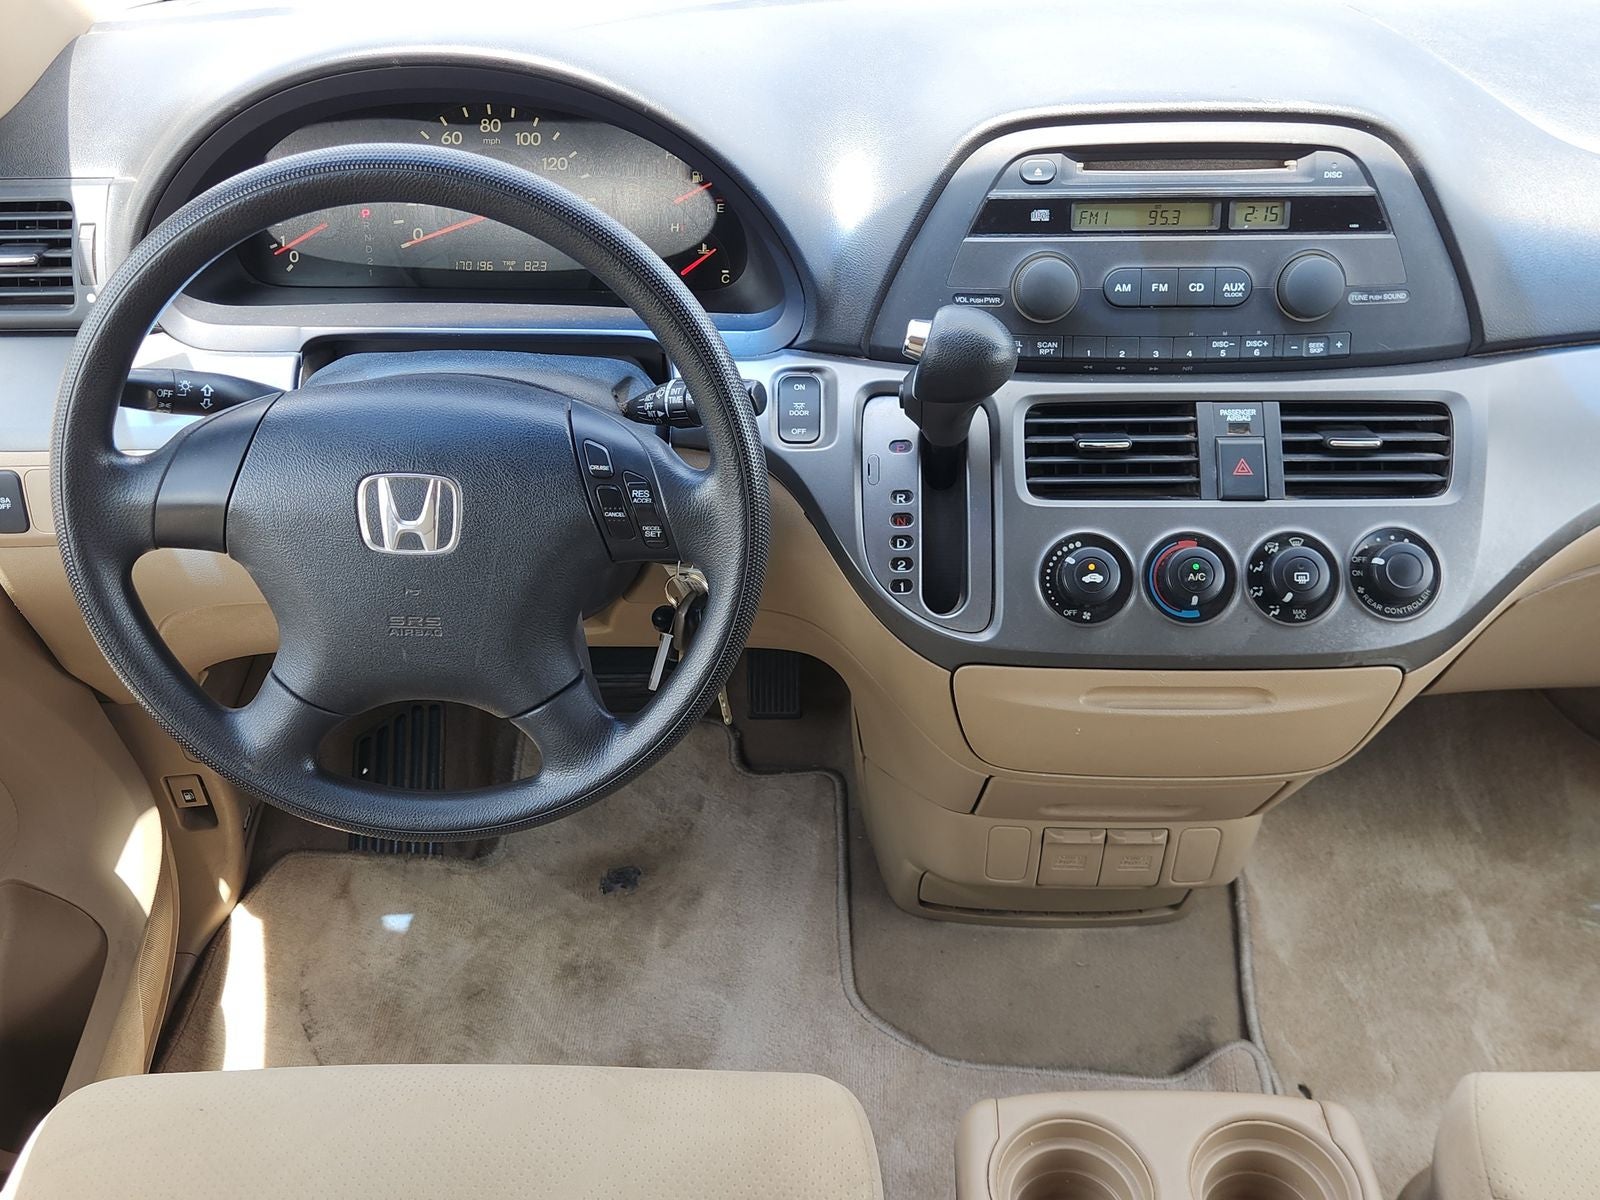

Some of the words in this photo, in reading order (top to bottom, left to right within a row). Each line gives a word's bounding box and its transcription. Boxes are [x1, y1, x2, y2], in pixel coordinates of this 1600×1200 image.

[480, 119, 501, 133] 80
[441, 131, 462, 145] 60
[483, 138, 501, 146] mph
[515, 132, 541, 146] 100
[542, 157, 568, 171] 120
[1324, 171, 1343, 179] DISC
[716, 203, 725, 213] E
[361, 208, 371, 218] P
[1148, 209, 1181, 226] 95.3
[1244, 205, 1279, 222] 2:15
[671, 223, 680, 233] H
[412, 228, 424, 241] 0
[279, 235, 286, 247] 1
[289, 250, 300, 263] 0
[721, 273, 731, 284] C
[1114, 284, 1132, 293] AM
[1152, 284, 1169, 293] FM
[1188, 283, 1205, 292] CD
[1222, 283, 1246, 292] AUX
[1351, 294, 1369, 302] TUNE
[1382, 293, 1407, 301] SOUND
[1036, 341, 1058, 349] SCAN
[1039, 348, 1055, 356] RPT
[1119, 350, 1126, 358] 2
[1152, 350, 1159, 358] 3
[1186, 350, 1193, 358] 4
[670, 387, 682, 395] INT
[793, 383, 806, 392] ON
[156, 388, 174, 398] OFF
[668, 396, 684, 405] TIME
[643, 402, 654, 411] OFF
[788, 409, 809, 417] DOOR
[1219, 408, 1257, 417] PASSENGER
[791, 428, 807, 436] OFF
[895, 444, 906, 453] P
[631, 489, 651, 498] RES
[896, 494, 907, 504] R
[896, 517, 907, 526] N
[644, 530, 663, 538] SET
[896, 538, 908, 549] D
[1351, 556, 1368, 564] OFF
[896, 559, 907, 571] 2
[1187, 572, 1207, 582] A/C
[1351, 569, 1364, 577] ON
[898, 582, 907, 593] 1
[1362, 592, 1384, 612] REAR
[1383, 588, 1432, 616] CONTROLLER
[1063, 609, 1078, 617] OFF
[1292, 608, 1308, 616] MAX
[388, 615, 442, 627] SRS
[389, 627, 443, 638] AIRBAG
